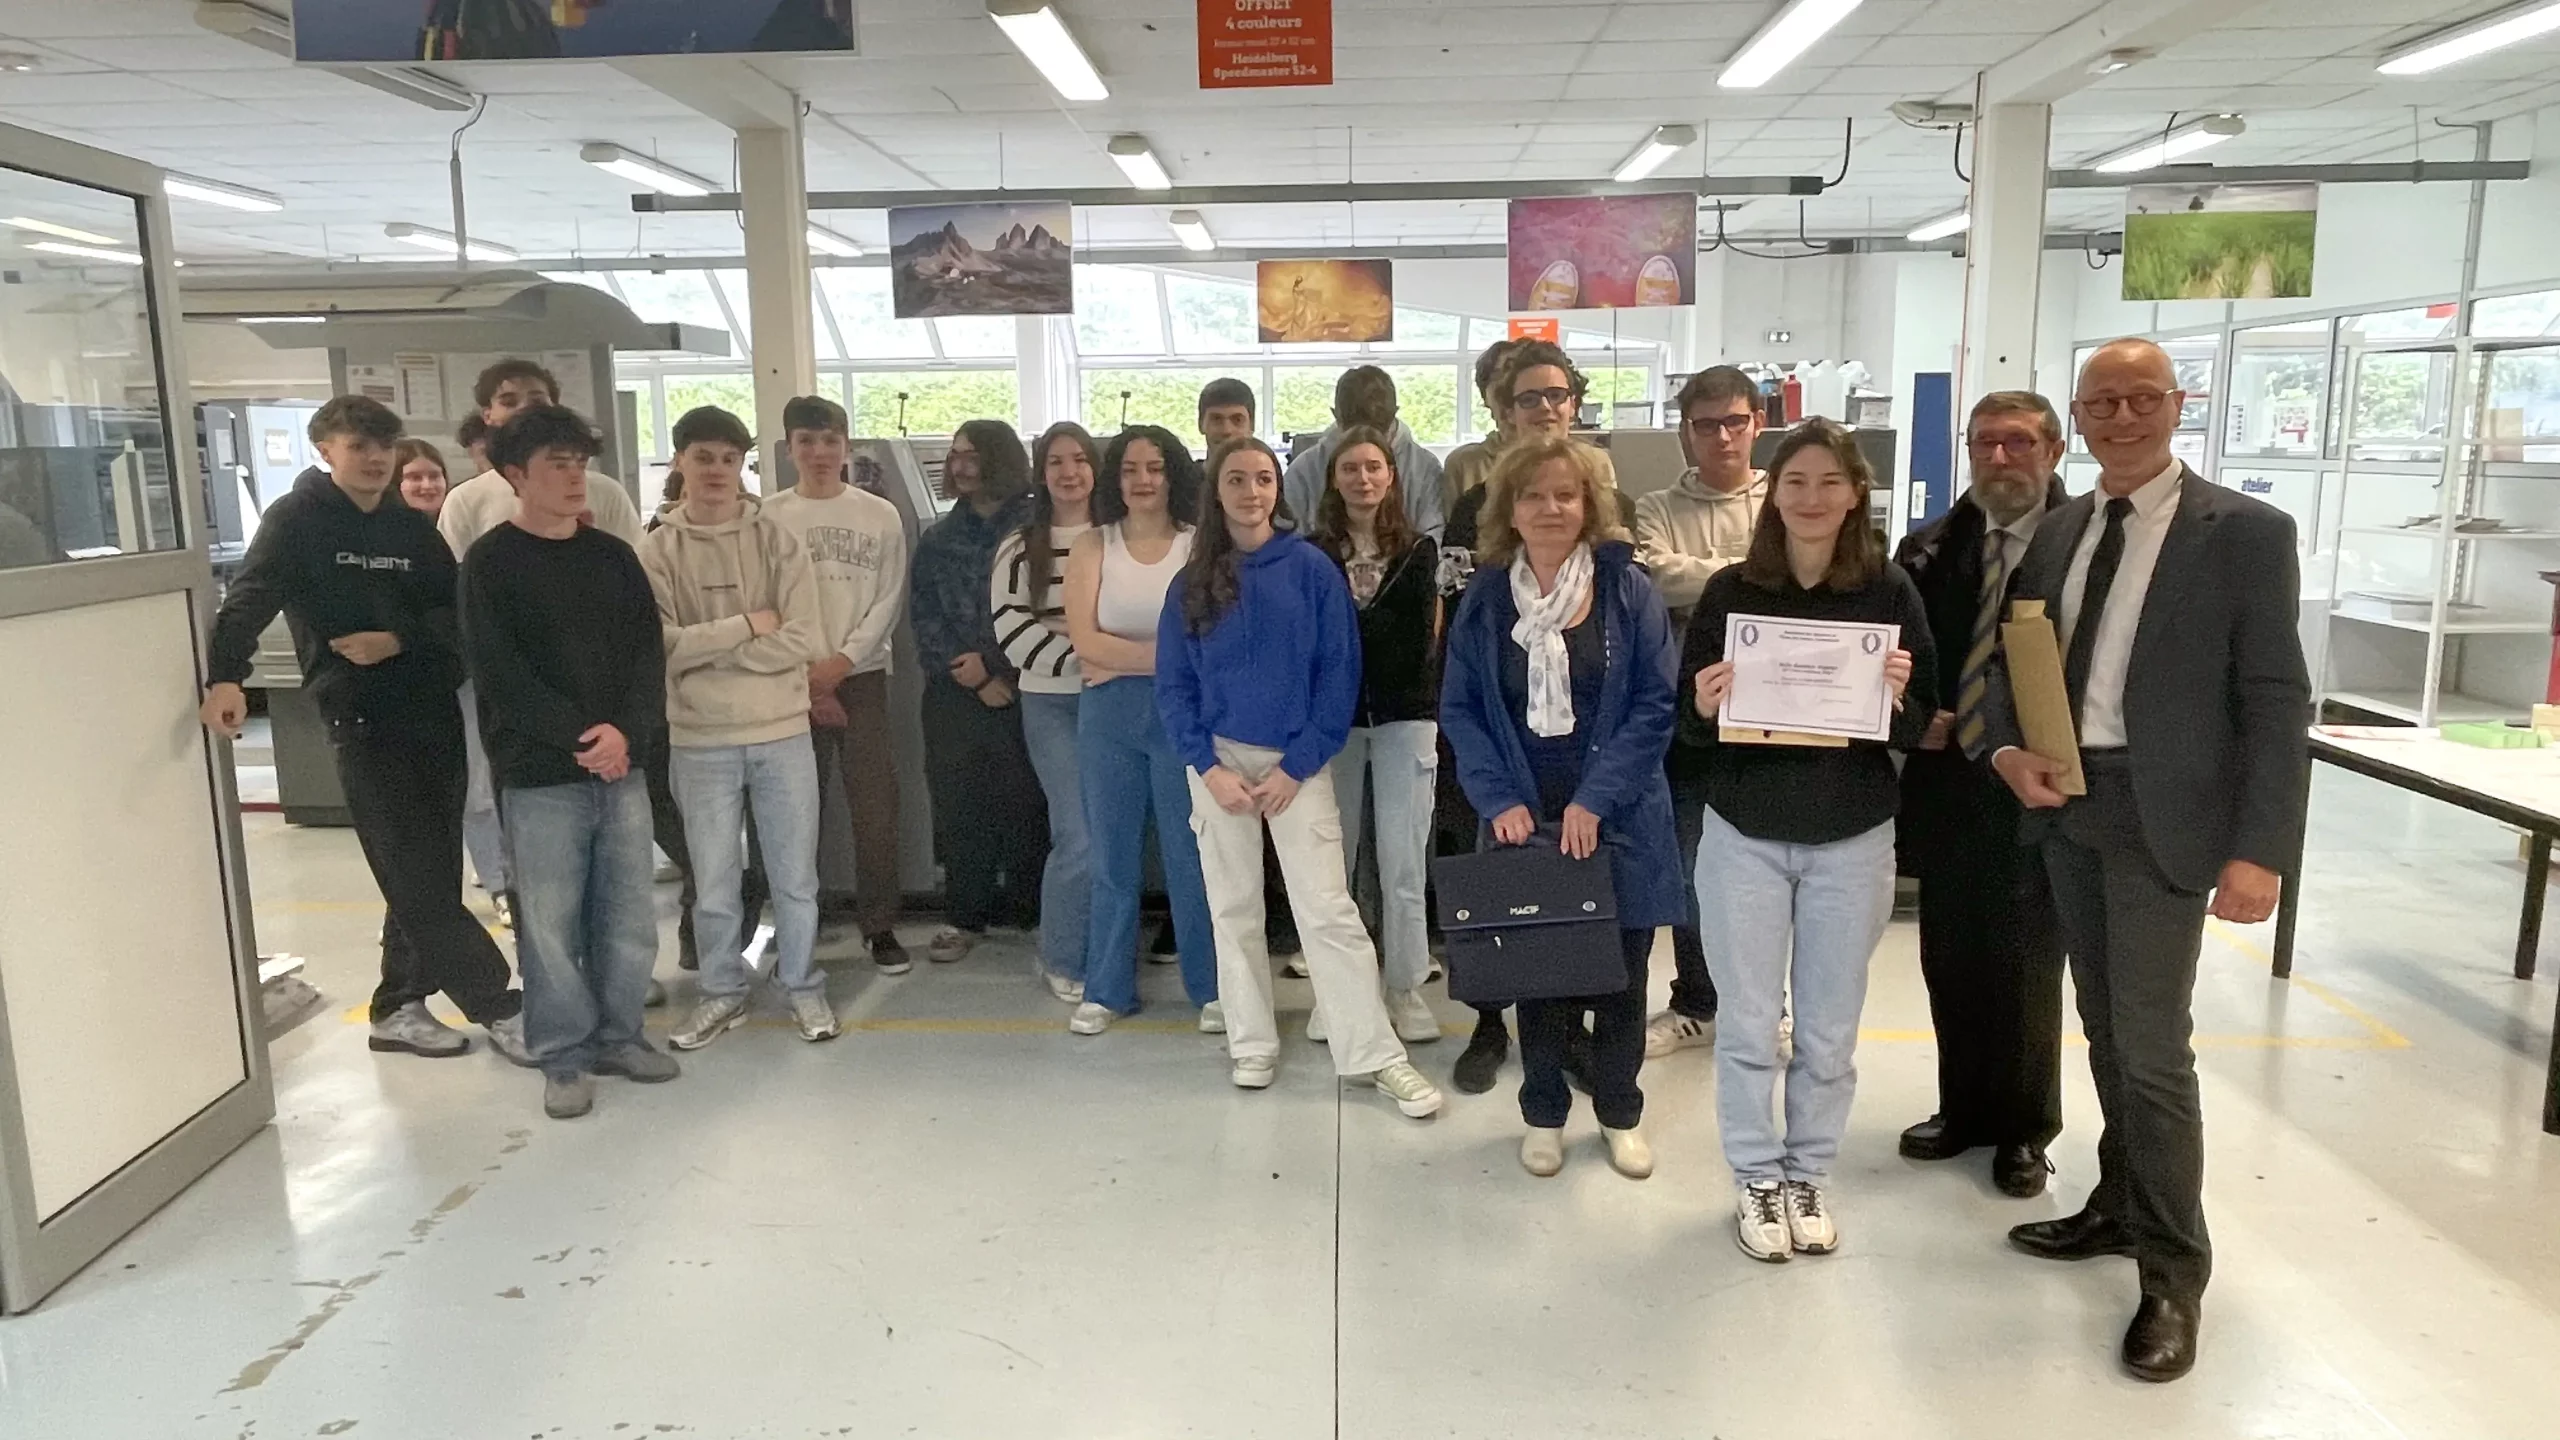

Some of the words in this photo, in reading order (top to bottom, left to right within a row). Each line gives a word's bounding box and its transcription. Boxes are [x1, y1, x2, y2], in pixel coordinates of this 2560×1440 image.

[1235, 0, 1292, 11] OFFSET
[1225, 16, 1235, 30] 4
[1237, 15, 1303, 29] couleurs
[1232, 52, 1298, 64] Heidelberg
[1213, 65, 1290, 80] Speedmaster
[2241, 476, 2274, 494] atelier
